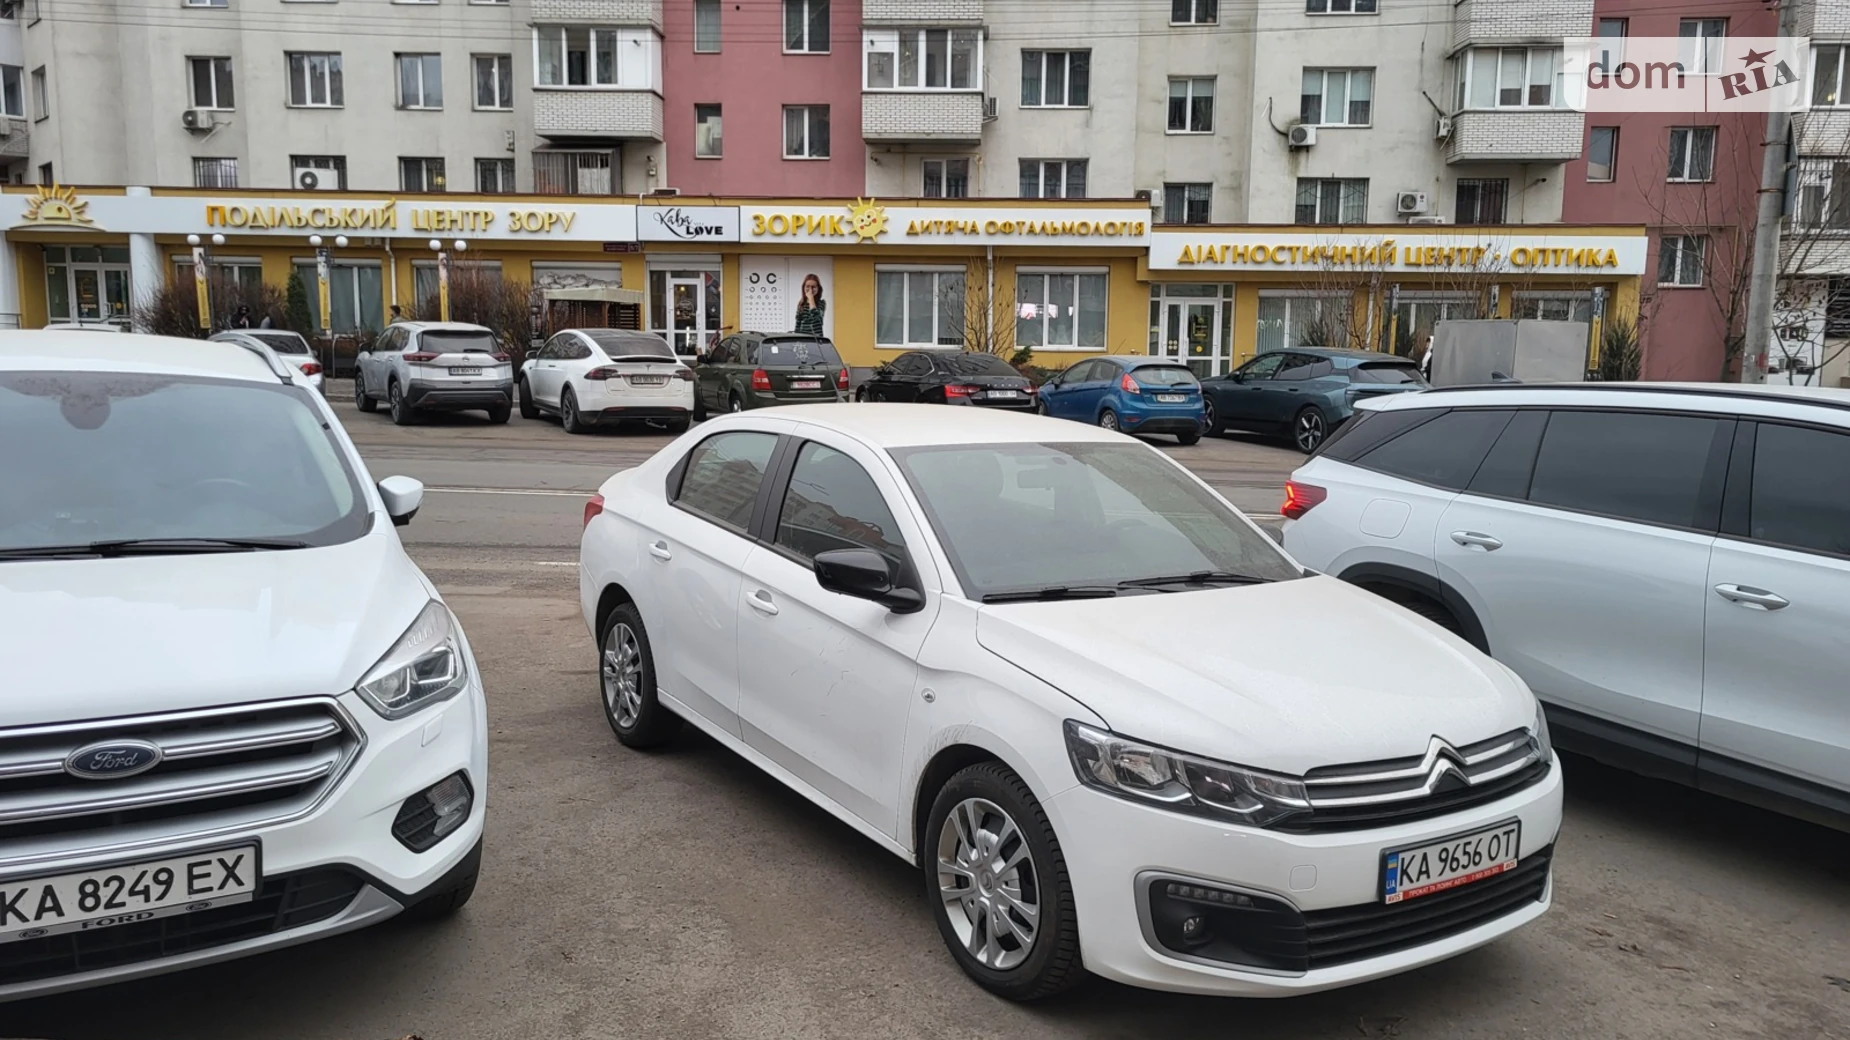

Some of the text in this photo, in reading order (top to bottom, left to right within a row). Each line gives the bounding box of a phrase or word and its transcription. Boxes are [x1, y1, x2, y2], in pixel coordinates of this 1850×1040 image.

[206, 198, 576, 232] ПОДІЛЬСЬКИЙ ЦЕНТР ЗОРУ
[686, 226, 723, 235] LOVE
[906, 220, 1145, 237] ДИТЯЧА ОФТАЛЬМОЛОГІЯ
[1177, 239, 1619, 268] ДІАГНОСТИЧНИЙ ЦЕНТР ОПТИКА
[89, 750, 138, 770] Ford
[1399, 828, 1515, 886] KA 9656 OT
[0, 854, 245, 926] KA 8249 EX
[1386, 879, 1396, 889] UA
[82, 912, 155, 929] FORD
